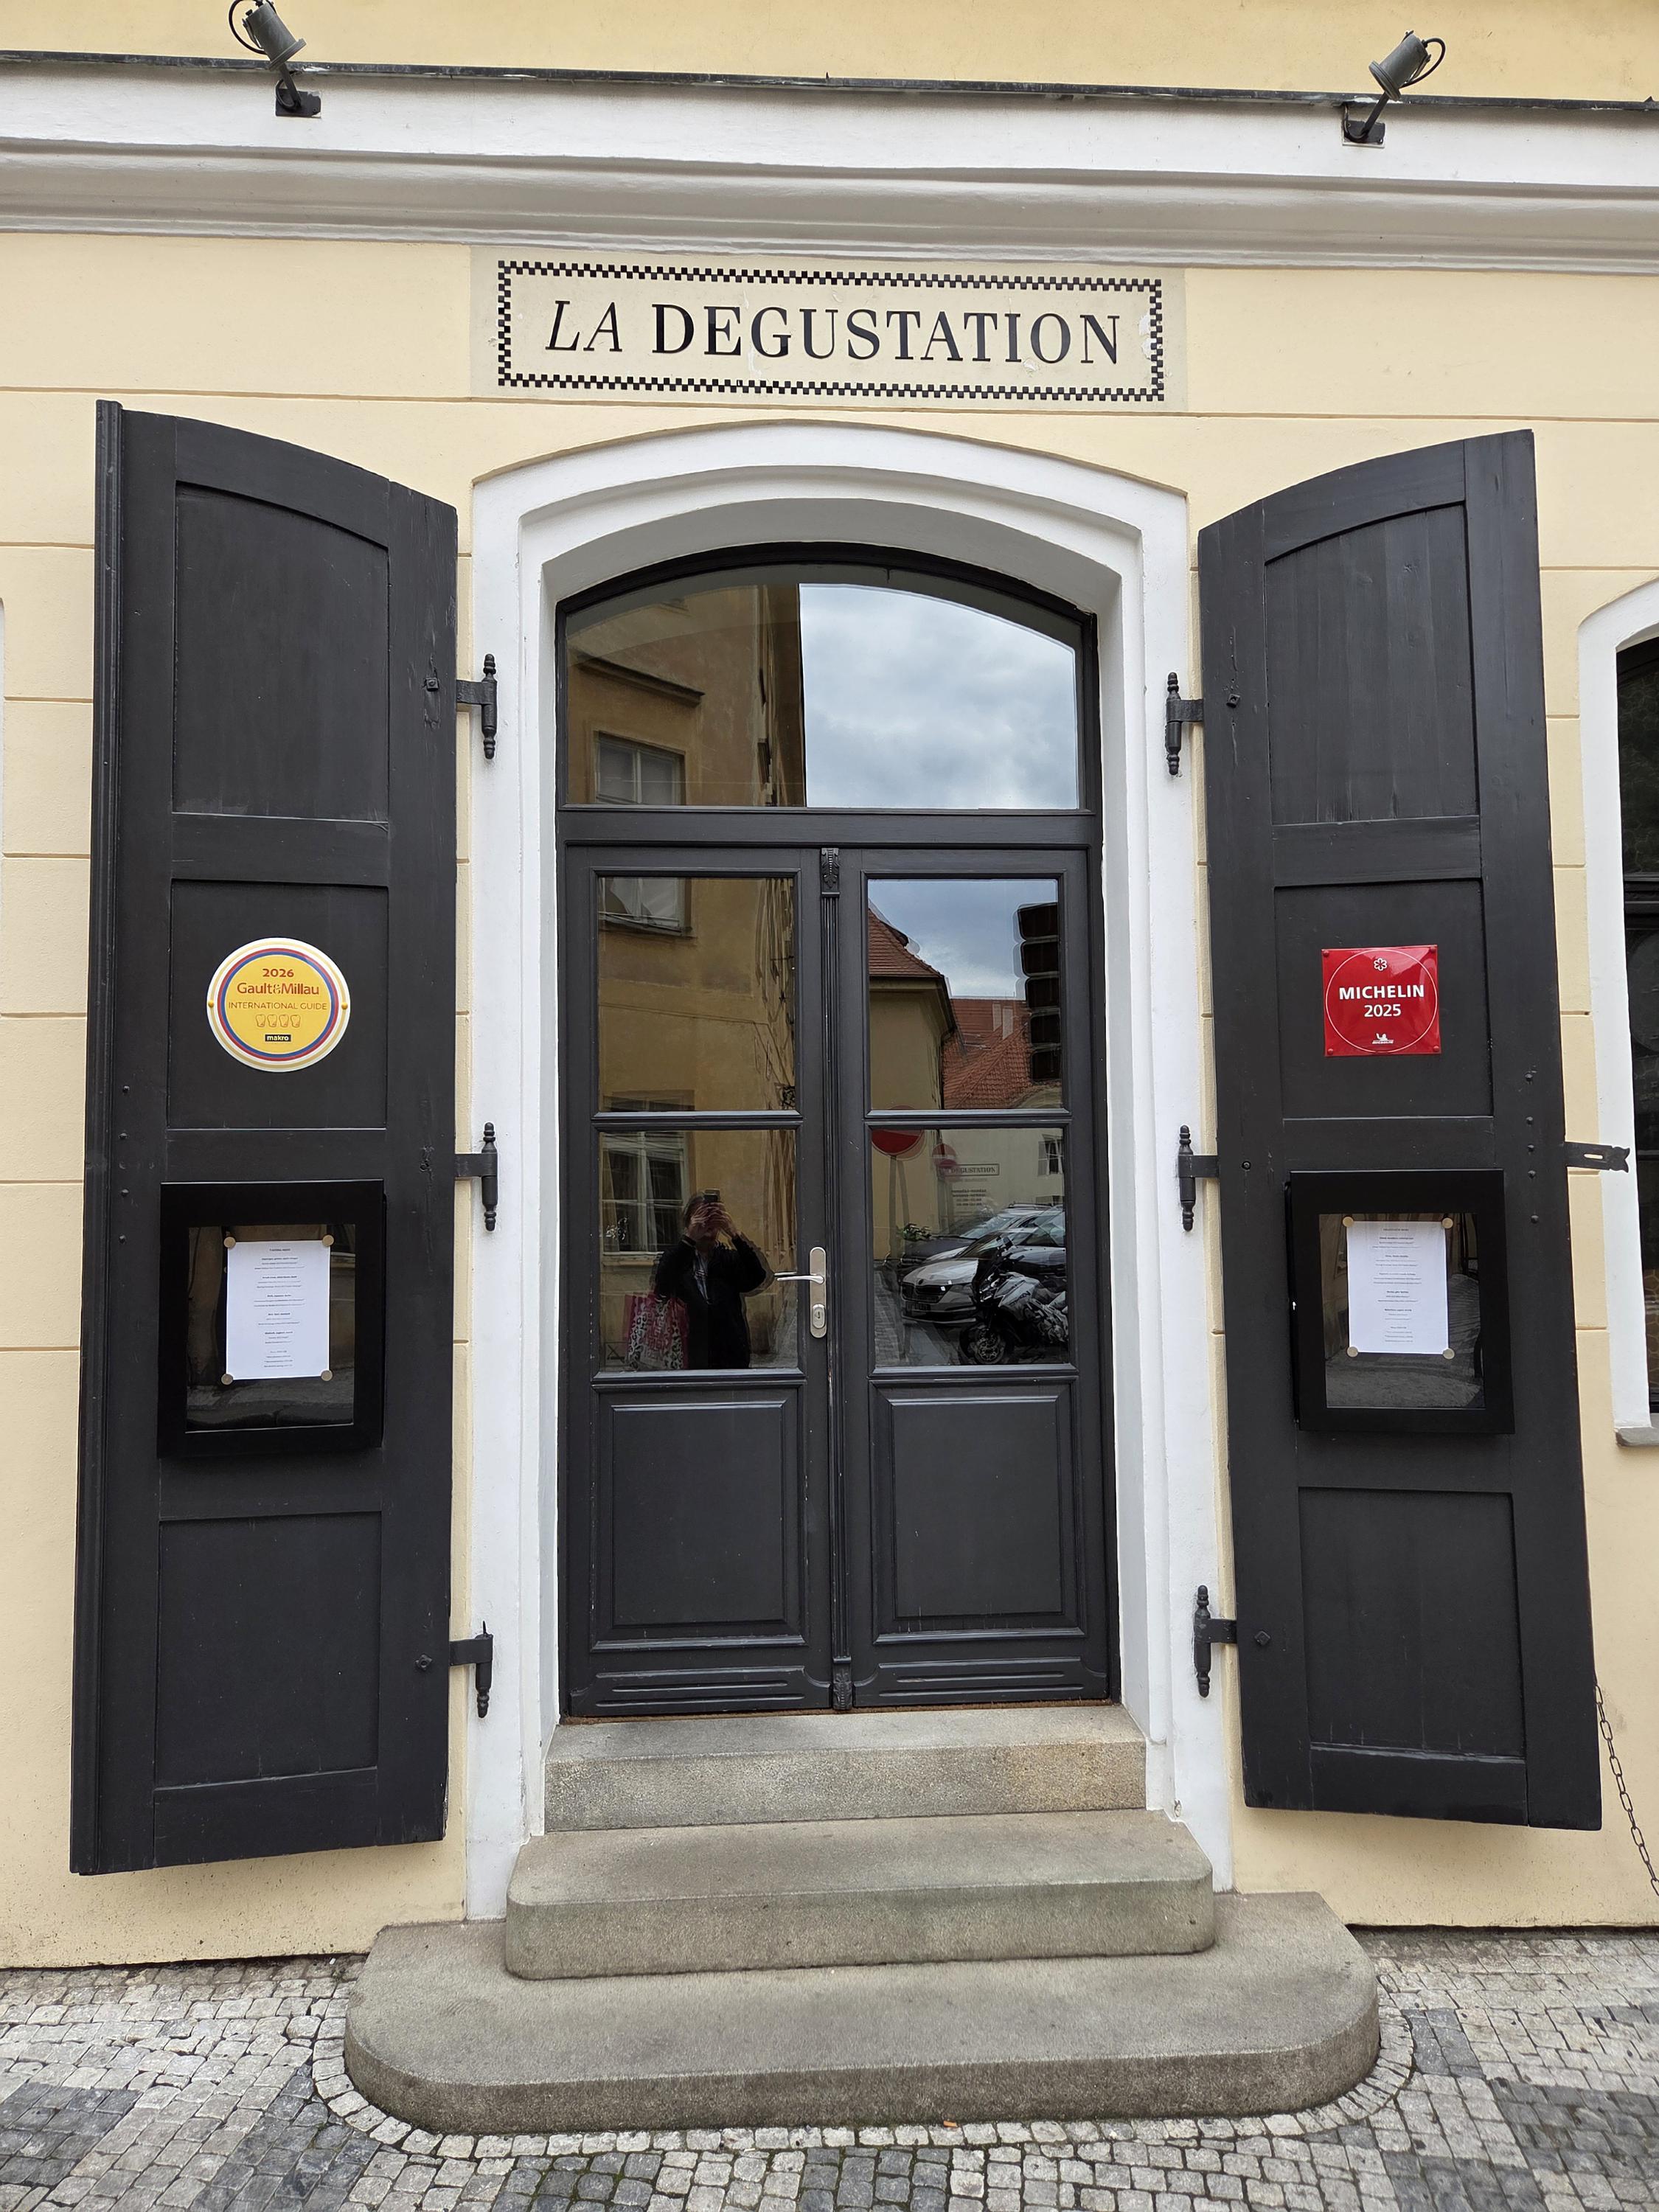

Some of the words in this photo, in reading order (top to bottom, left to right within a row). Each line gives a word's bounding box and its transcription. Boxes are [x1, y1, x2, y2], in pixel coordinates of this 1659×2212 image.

[545, 300, 623, 352] LA
[651, 302, 1121, 364] DEGUSTATION
[262, 968, 295, 978] 2026
[237, 982, 319, 995] Gault&Millau
[1339, 984, 1425, 1000] MICHELIN
[228, 1001, 298, 1009] INTERNATIONAL
[1364, 1004, 1402, 1017] 2025
